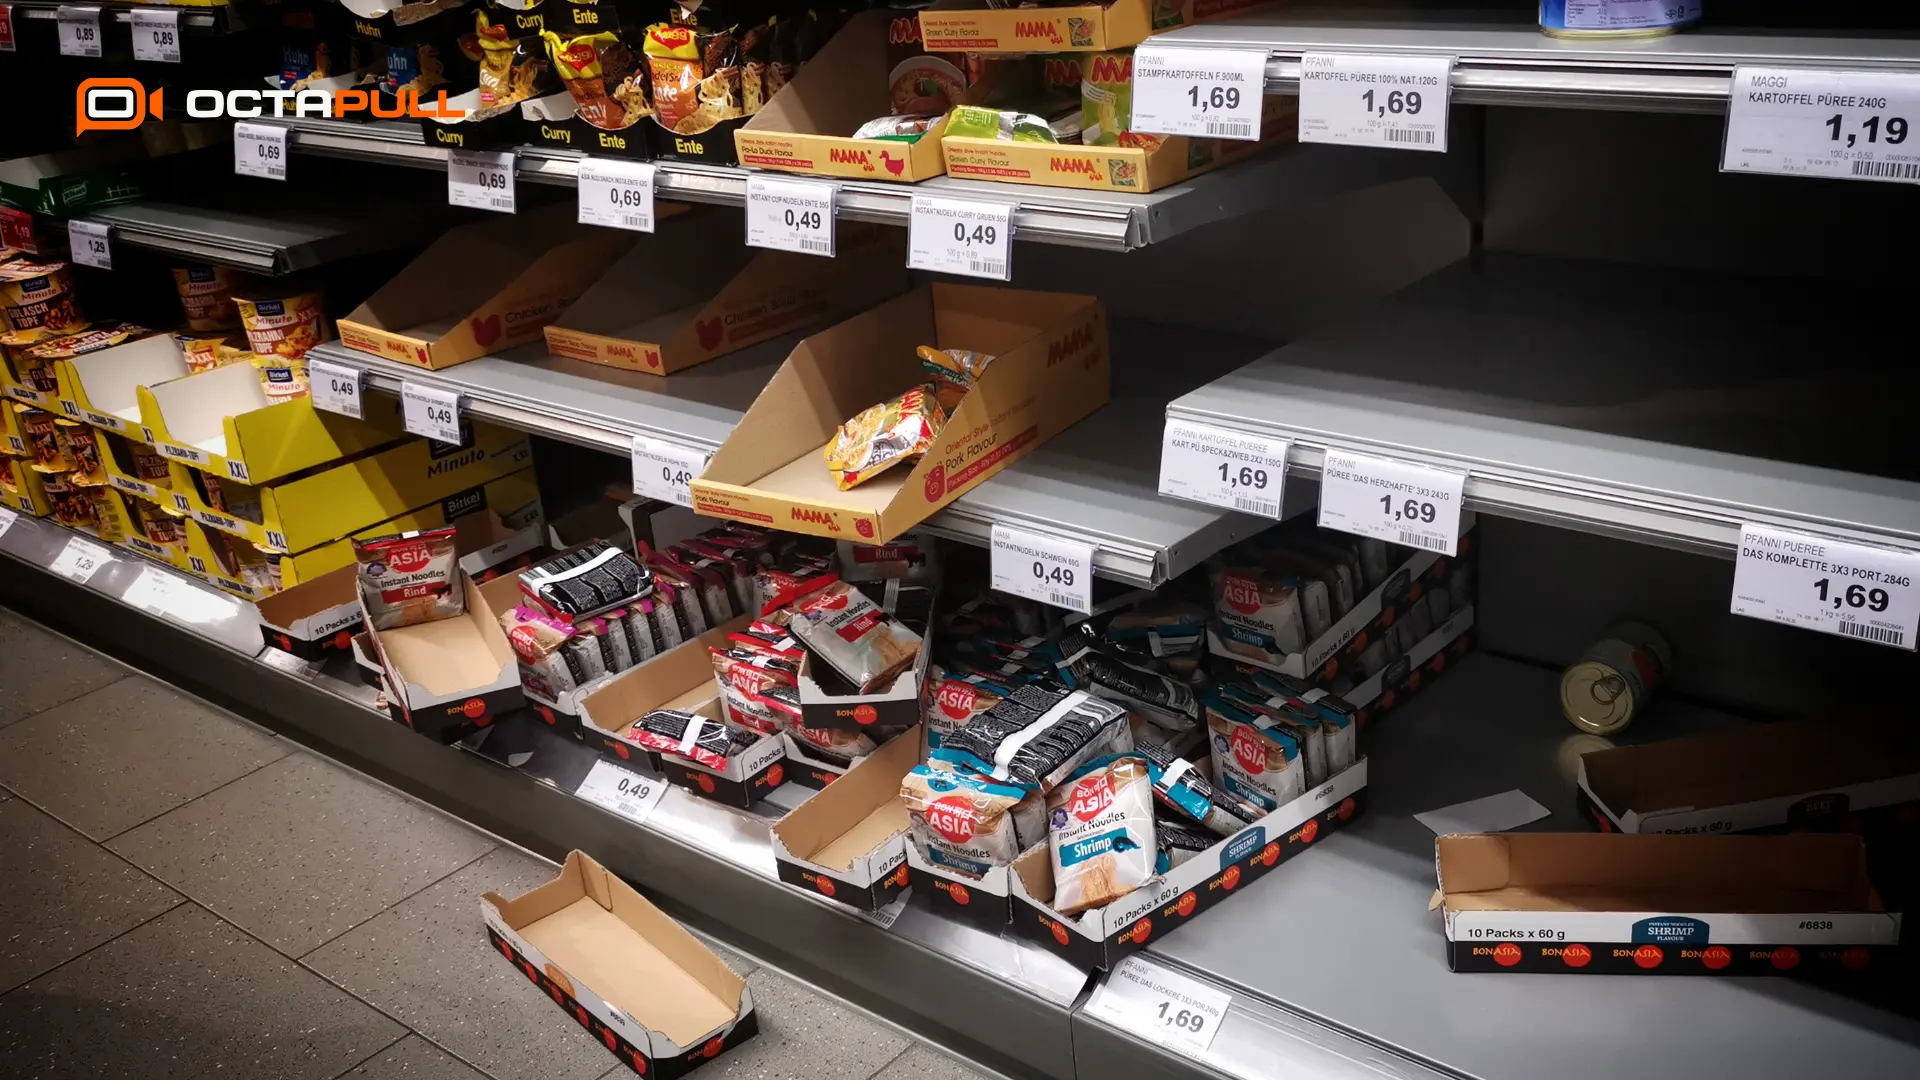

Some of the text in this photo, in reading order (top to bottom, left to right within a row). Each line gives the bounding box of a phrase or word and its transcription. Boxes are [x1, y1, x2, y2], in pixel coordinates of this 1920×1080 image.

[516, 13, 545, 29] Curry
[573, 9, 599, 24] Ente
[76, 28, 94, 42] 0,89
[356, 20, 381, 39] Huhn
[1016, 22, 1057, 38] MAMA
[153, 31, 174, 47] 0,89
[1139, 56, 1165, 65] PFANNI
[1305, 57, 1335, 67] PFANNI
[1138, 69, 1244, 81] STAMPFKARTOFFELN F.900ML
[1304, 72, 1437, 85] KARTOFFEL PÜREE 100% NAT.120G
[1751, 76, 1788, 88] MAGGI
[1188, 85, 1240, 112] 1,69
[1362, 89, 1422, 118] 1,69
[1749, 92, 1886, 108] KARTOFFEL PÜREE 240G
[436, 129, 464, 147] Curry
[541, 125, 571, 143] Curry
[1826, 114, 1909, 148] 1,19
[599, 133, 626, 150] Ente
[676, 138, 703, 155] Ente
[258, 144, 280, 160] 0,69
[830, 148, 868, 164] MAMA
[1830, 150, 1873, 160] 100 g 0,50
[1050, 157, 1095, 174] MAMA
[479, 172, 506, 191] 0,69
[610, 188, 641, 208] 0,69
[750, 193, 771, 202] INSTANT
[804, 199, 818, 208] ENTE
[785, 209, 821, 231] 0,49
[915, 206, 957, 218] INSTANTNUDELN
[957, 210, 976, 219] CURRY
[954, 222, 996, 246] 0,49
[88, 239, 105, 254] 1,29
[607, 344, 633, 358] MAMA
[332, 379, 353, 396] 0,49
[428, 406, 451, 424] 0,49
[945, 423, 988, 454] Oriental Style
[1173, 427, 1269, 454] PFANNI KARTOFFEL PUEREE
[946, 432, 998, 474] Pork Flavour
[228, 461, 248, 479] XXL
[428, 450, 484, 478] Minuto
[1265, 459, 1281, 468] 150G
[1327, 456, 1356, 470] PFANNI
[1218, 462, 1268, 489] 1,69
[1326, 468, 1354, 481] PÜREE
[1416, 487, 1430, 497] 3X3
[1431, 490, 1449, 501] 243G
[448, 492, 480, 512] Birkel
[1380, 494, 1436, 524] 1,69
[791, 507, 834, 525] MAMA
[266, 530, 287, 549] XXL
[1744, 533, 1826, 557] PFANNI PUEREE
[389, 549, 433, 567] ASIA
[875, 549, 897, 560] Rind
[994, 540, 1040, 557] INSTANTNUDELN
[1040, 551, 1067, 565] SCHWEIN
[75, 556, 94, 570] 1,29
[1743, 548, 1910, 587] DAS KOMPLETTE 3X3 PORT.284G
[381, 570, 445, 588] Instant Noodles
[1033, 561, 1074, 586] 0,49
[404, 586, 427, 598] Rind
[1223, 583, 1261, 606] ASIA
[1814, 578, 1889, 612] 1,69
[826, 611, 851, 628] Instant
[1242, 615, 1274, 631] Noodles
[1825, 610, 1833, 619] kg
[314, 616, 350, 635] 10 Packs
[853, 616, 873, 632] Rind
[1231, 627, 1263, 646] Shrimp
[732, 673, 759, 695] ASIA
[447, 700, 485, 716] BONASIA
[937, 690, 973, 711] ASIA
[928, 715, 952, 730] Instant
[749, 748, 781, 772] 10 Packs
[1233, 738, 1267, 771] ASIA
[618, 778, 650, 799] 0,49
[1246, 774, 1277, 796] Noodles
[1072, 787, 1116, 815] ASIA
[1235, 782, 1265, 807] Shrimp
[929, 811, 973, 836] ASIA
[1088, 812, 1125, 830] Noodles
[1709, 821, 1724, 832] 60
[952, 844, 991, 858] Noodles
[1074, 838, 1112, 858] Shrimp
[1229, 836, 1258, 858] SHRIMP
[878, 863, 888, 874] 10
[943, 854, 978, 873] Shrimp
[1113, 886, 1179, 928] 10 Packs 60 g
[1468, 929, 1482, 938] 10
[1486, 928, 1524, 938] Packs
[1539, 929, 1554, 938] 60
[1557, 931, 1565, 940] g
[1648, 927, 1695, 936] SHRIMP
[1798, 921, 1833, 930] #6838
[1473, 947, 1521, 956] BONASIA
[1541, 948, 1591, 957] BONASIA
[1613, 949, 1662, 958] BONASIA
[1681, 950, 1730, 959] BONASIA
[1125, 960, 1149, 976] PFANNI
[1140, 977, 1153, 989] DAS
[1153, 982, 1182, 1000] LOCKERE
[1181, 993, 1193, 1005] 3X3
[1158, 1001, 1205, 1034] 1,69
